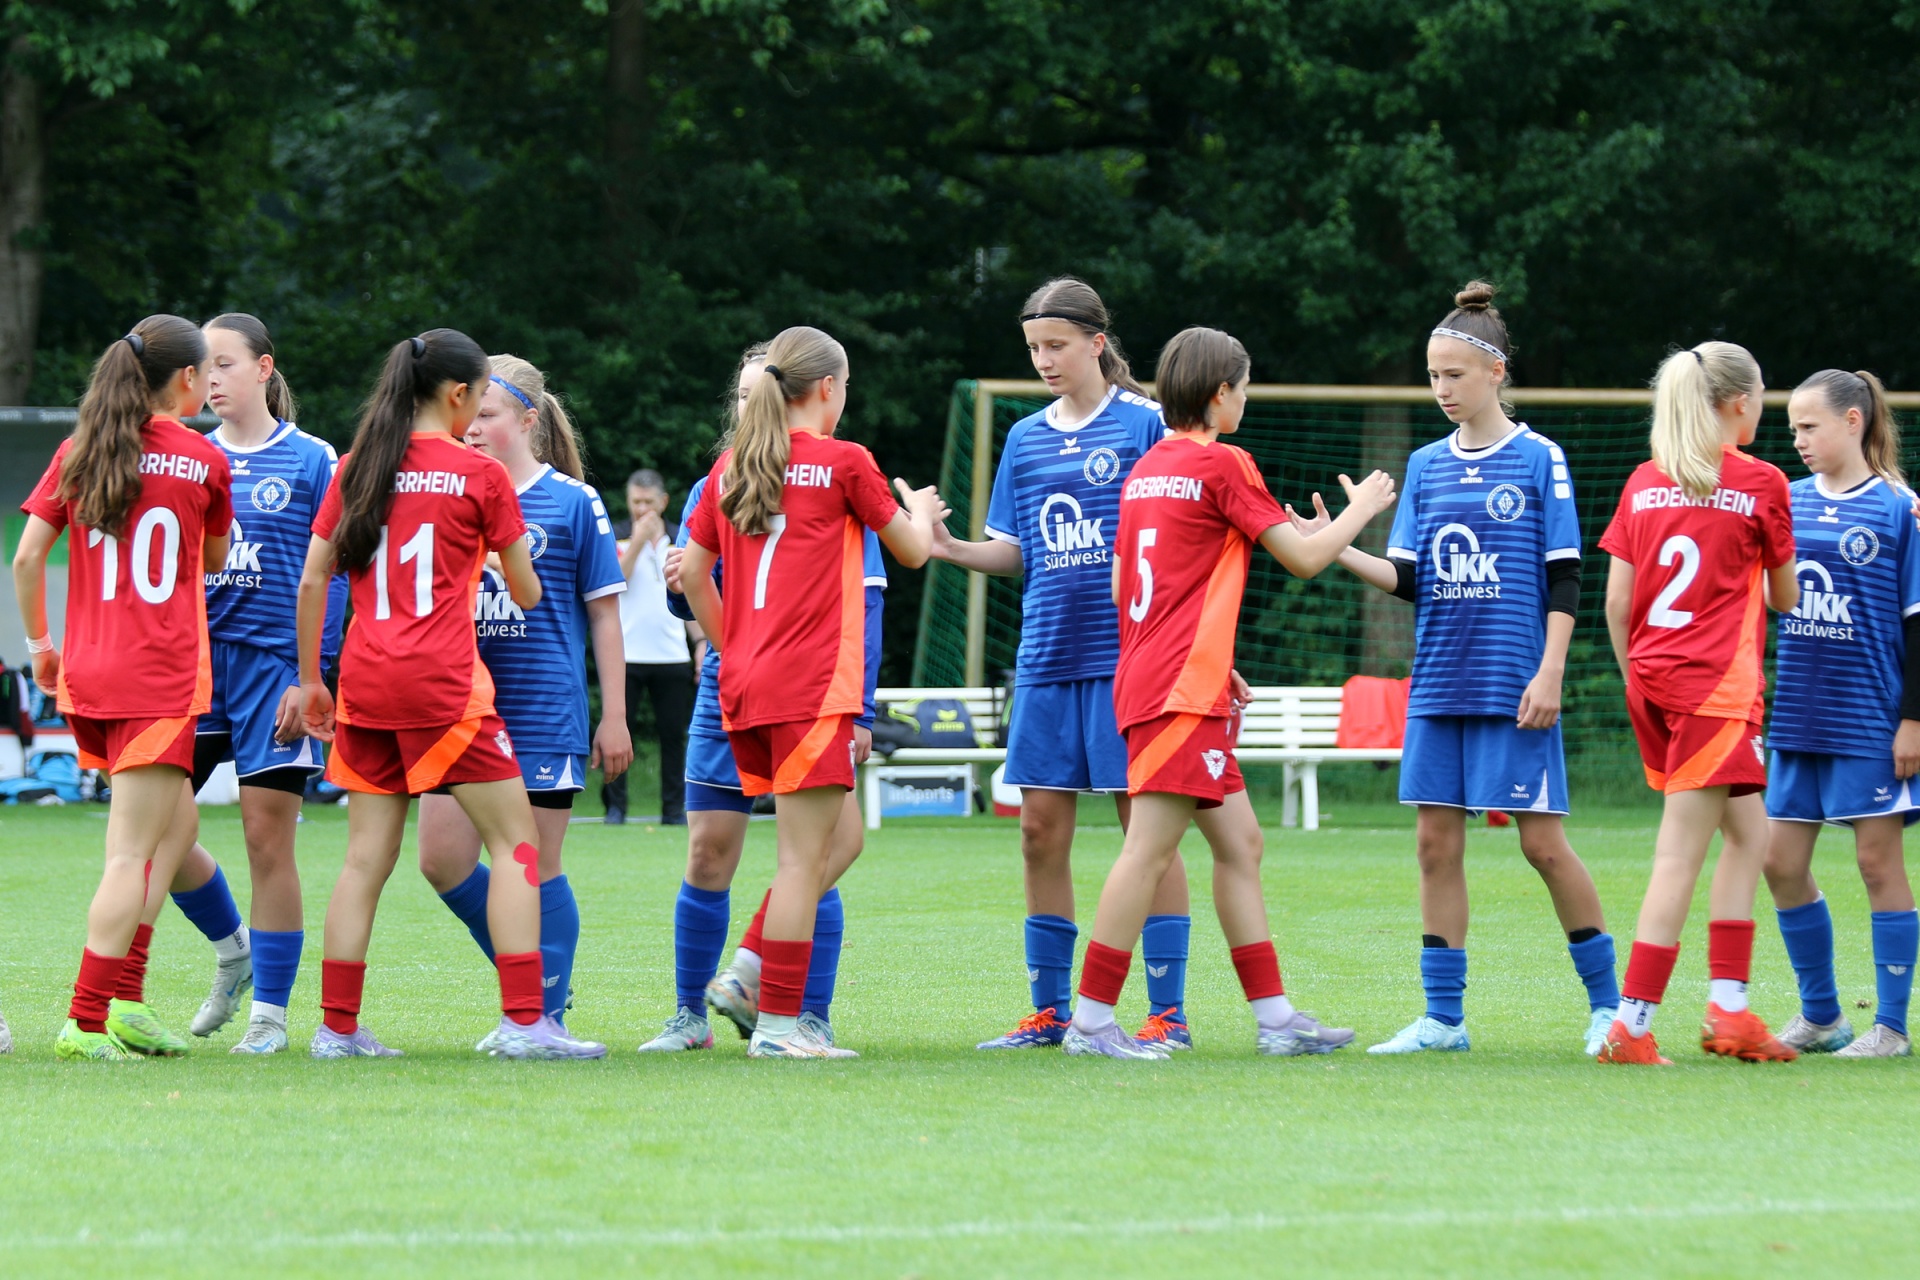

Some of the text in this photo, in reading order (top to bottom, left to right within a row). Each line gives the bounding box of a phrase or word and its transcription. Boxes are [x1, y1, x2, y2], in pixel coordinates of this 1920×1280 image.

[138, 452, 210, 485] RRHEIN
[1460, 475, 1483, 484] erima
[394, 471, 467, 497] RRHEIN
[89, 506, 180, 604] 10
[748, 514, 787, 609] 7
[1044, 548, 1109, 572] Südwest
[368, 523, 434, 620] 11
[1129, 528, 1157, 623] 5
[1648, 535, 1700, 629] 2
[1432, 582, 1502, 600] Südwest
[477, 620, 527, 638] dwest
[1784, 618, 1855, 641] Südwest
